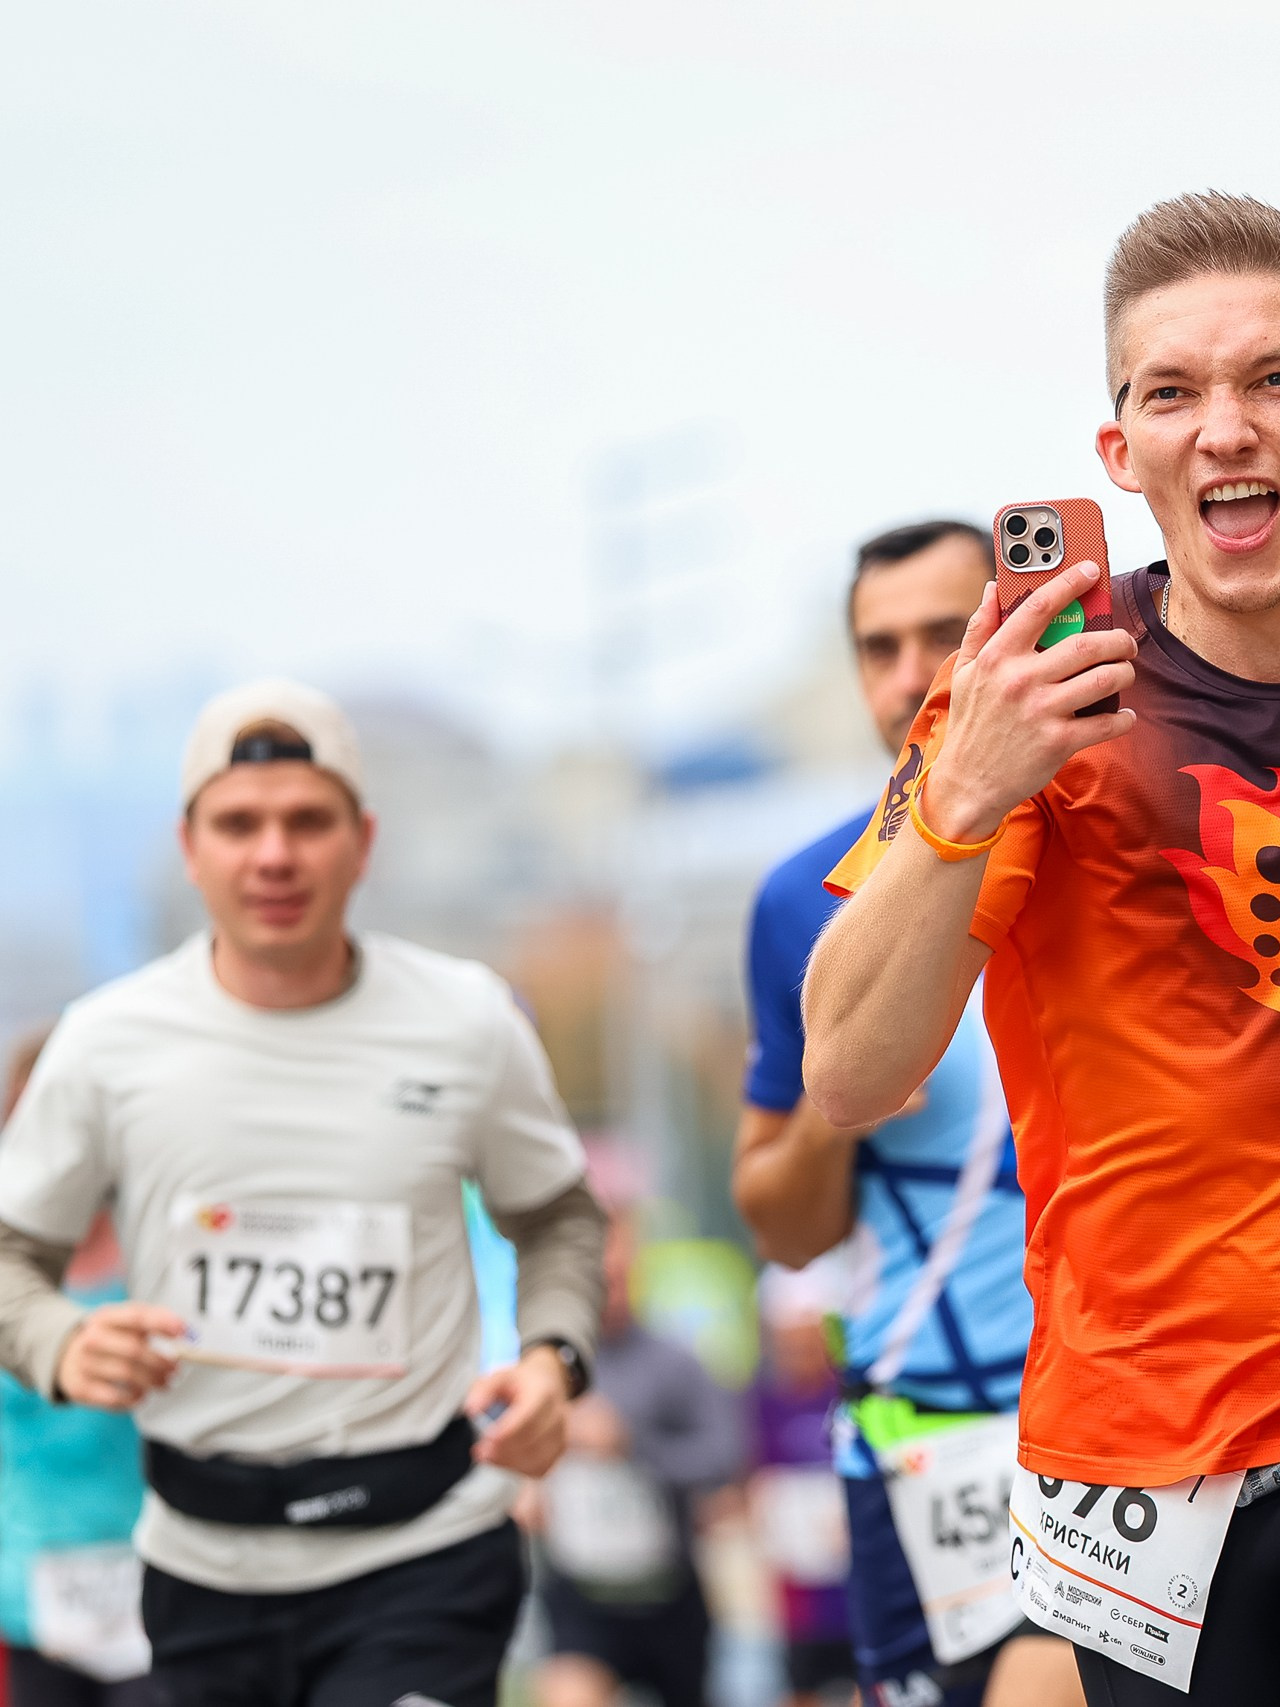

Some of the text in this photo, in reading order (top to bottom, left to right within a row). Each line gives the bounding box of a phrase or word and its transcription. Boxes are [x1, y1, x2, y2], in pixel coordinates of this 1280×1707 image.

[1050, 611, 1081, 625] УТНЫЙ
[189, 1254, 397, 1330] 17387
[1176, 1583, 1188, 1599] 2
[1121, 1614, 1145, 1629] СБЕР
[1132, 1645, 1158, 1662] WINLINE
